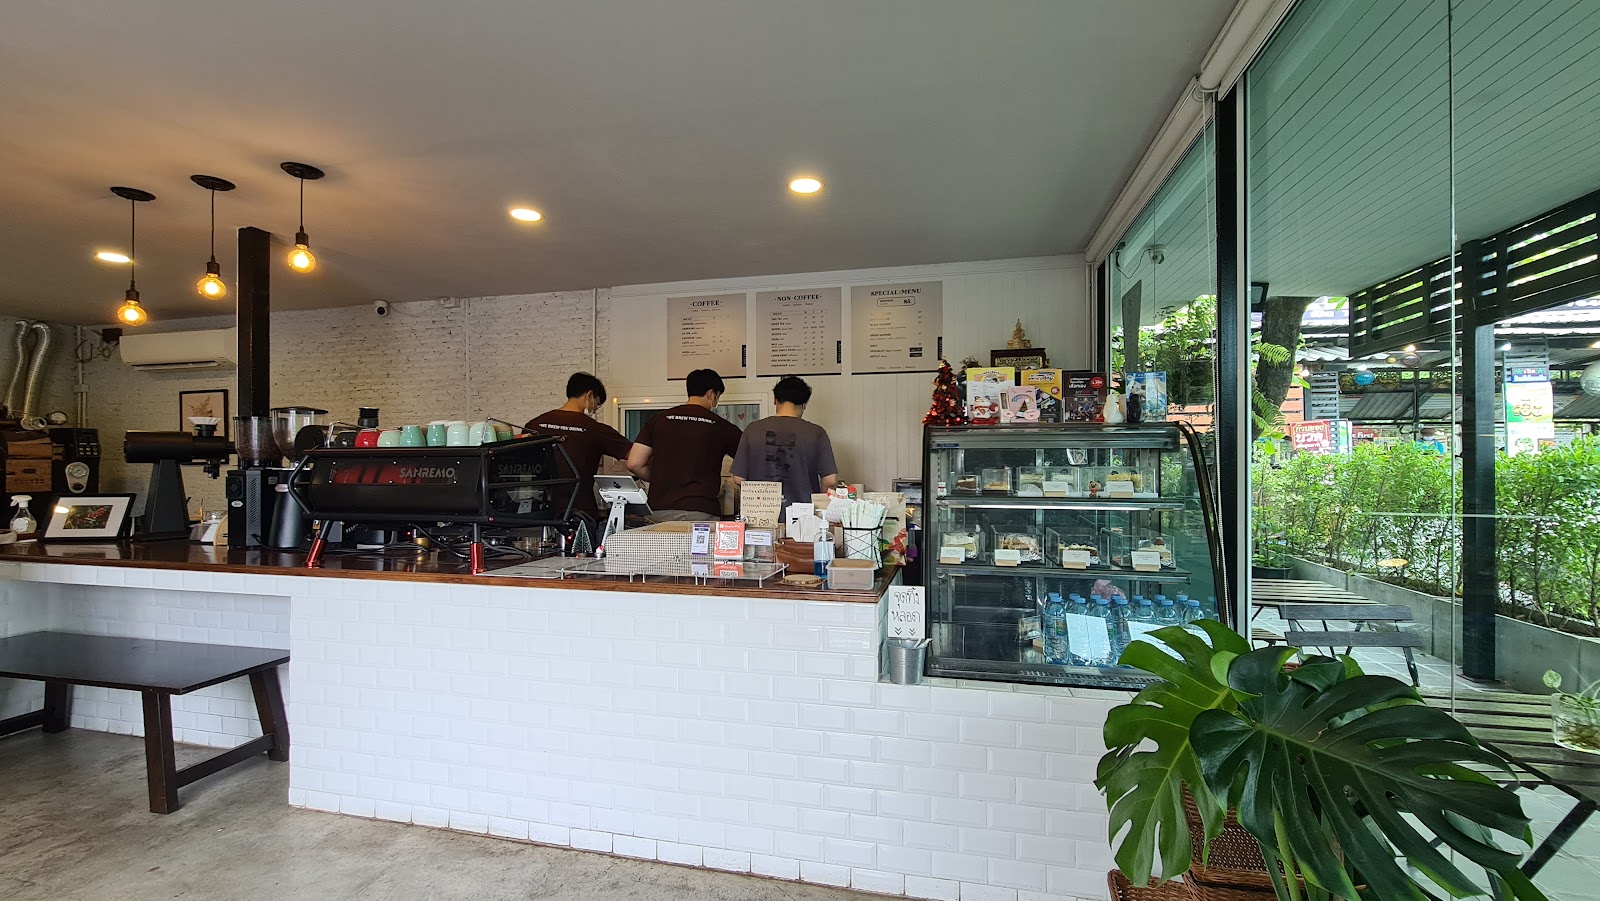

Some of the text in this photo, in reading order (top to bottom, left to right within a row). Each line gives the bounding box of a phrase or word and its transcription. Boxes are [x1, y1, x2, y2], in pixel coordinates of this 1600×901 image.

[399, 467, 455, 478] SANREMO
[497, 463, 542, 475] SANREMO
[893, 587, 920, 609] จุดทิ้ง
